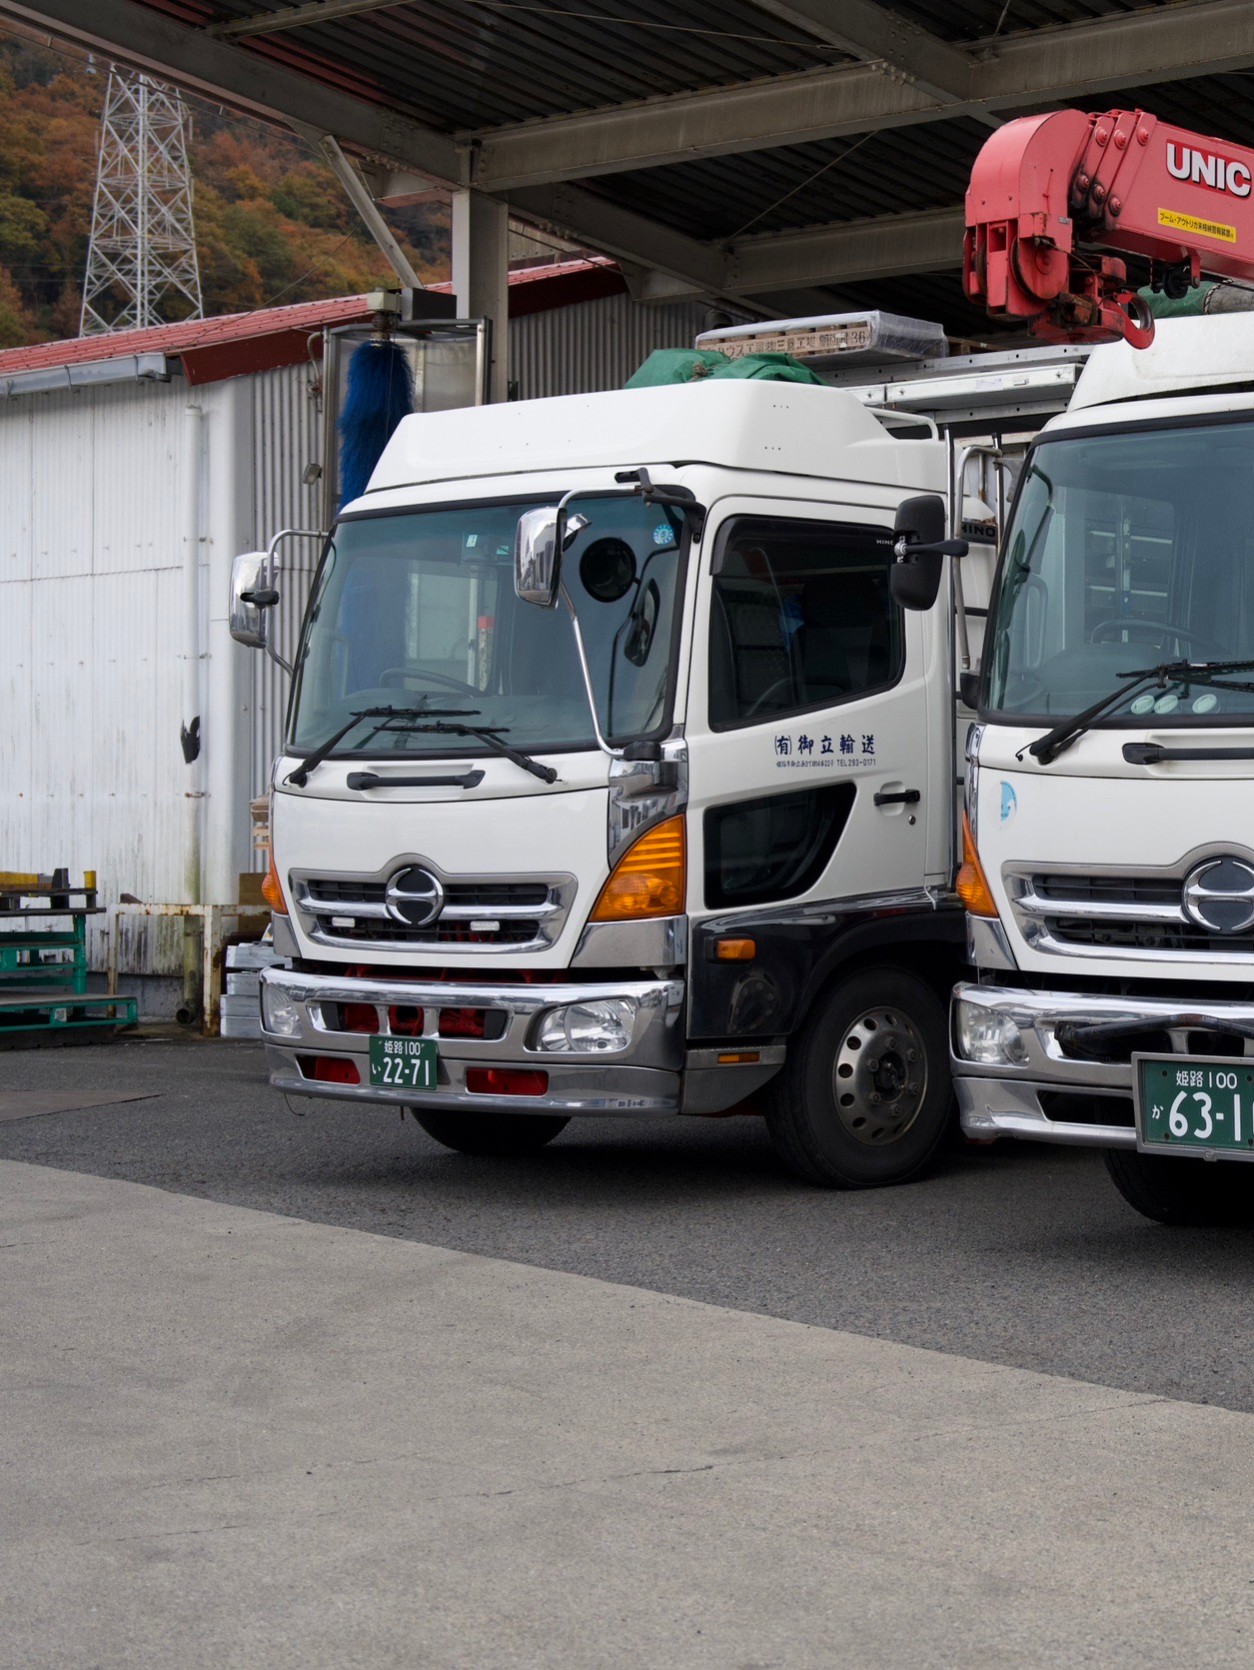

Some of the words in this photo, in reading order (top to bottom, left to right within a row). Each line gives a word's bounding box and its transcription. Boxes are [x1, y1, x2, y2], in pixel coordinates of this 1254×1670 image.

[1166, 143, 1252, 198] UNIC
[371, 1063, 381, 1075] い
[383, 1057, 429, 1086] 22-71
[1152, 1104, 1163, 1120] か
